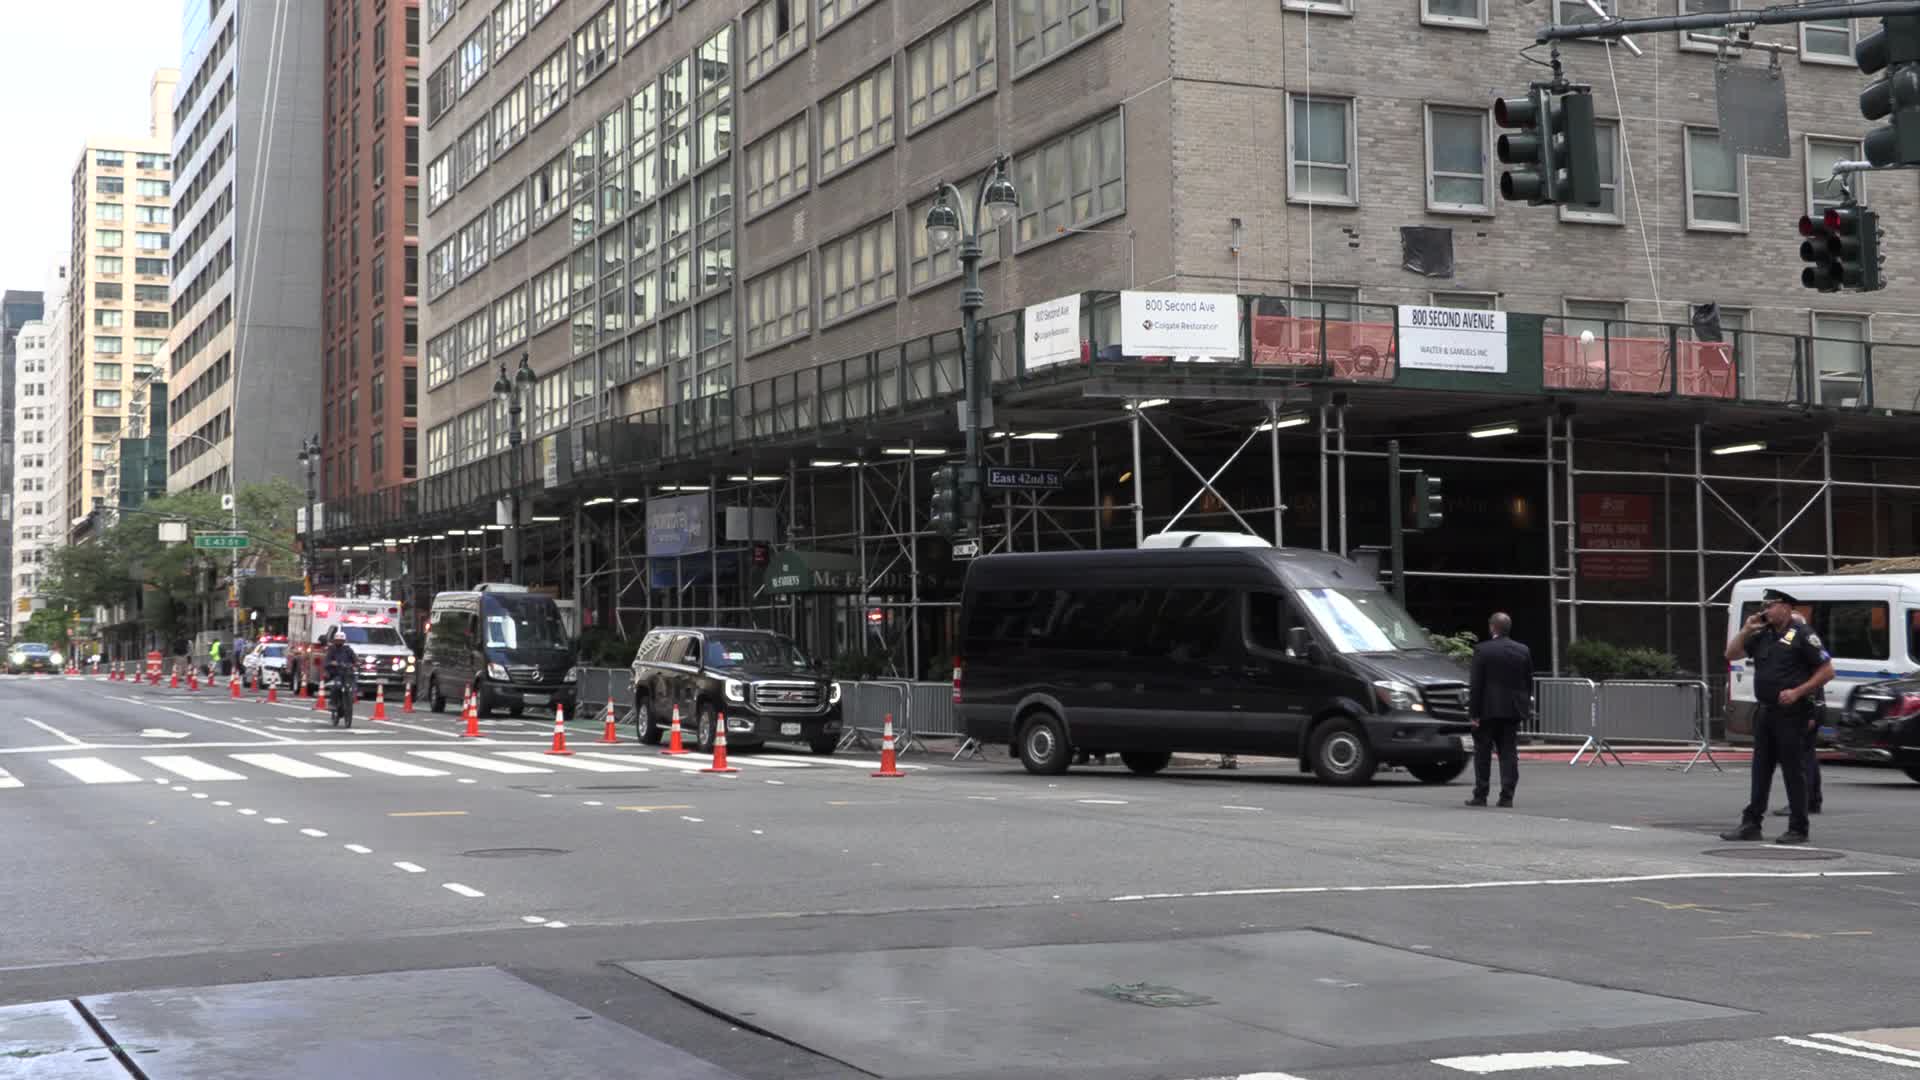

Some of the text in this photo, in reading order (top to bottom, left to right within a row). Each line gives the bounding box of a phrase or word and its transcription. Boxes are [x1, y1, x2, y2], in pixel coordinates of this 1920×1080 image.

[1145, 299, 1216, 312] 800 Second Ave
[1154, 321, 1218, 331] Colgate Restoration
[1412, 309, 1495, 330] 800 SECOND AVENUE
[992, 472, 1058, 485] East 42nd St
